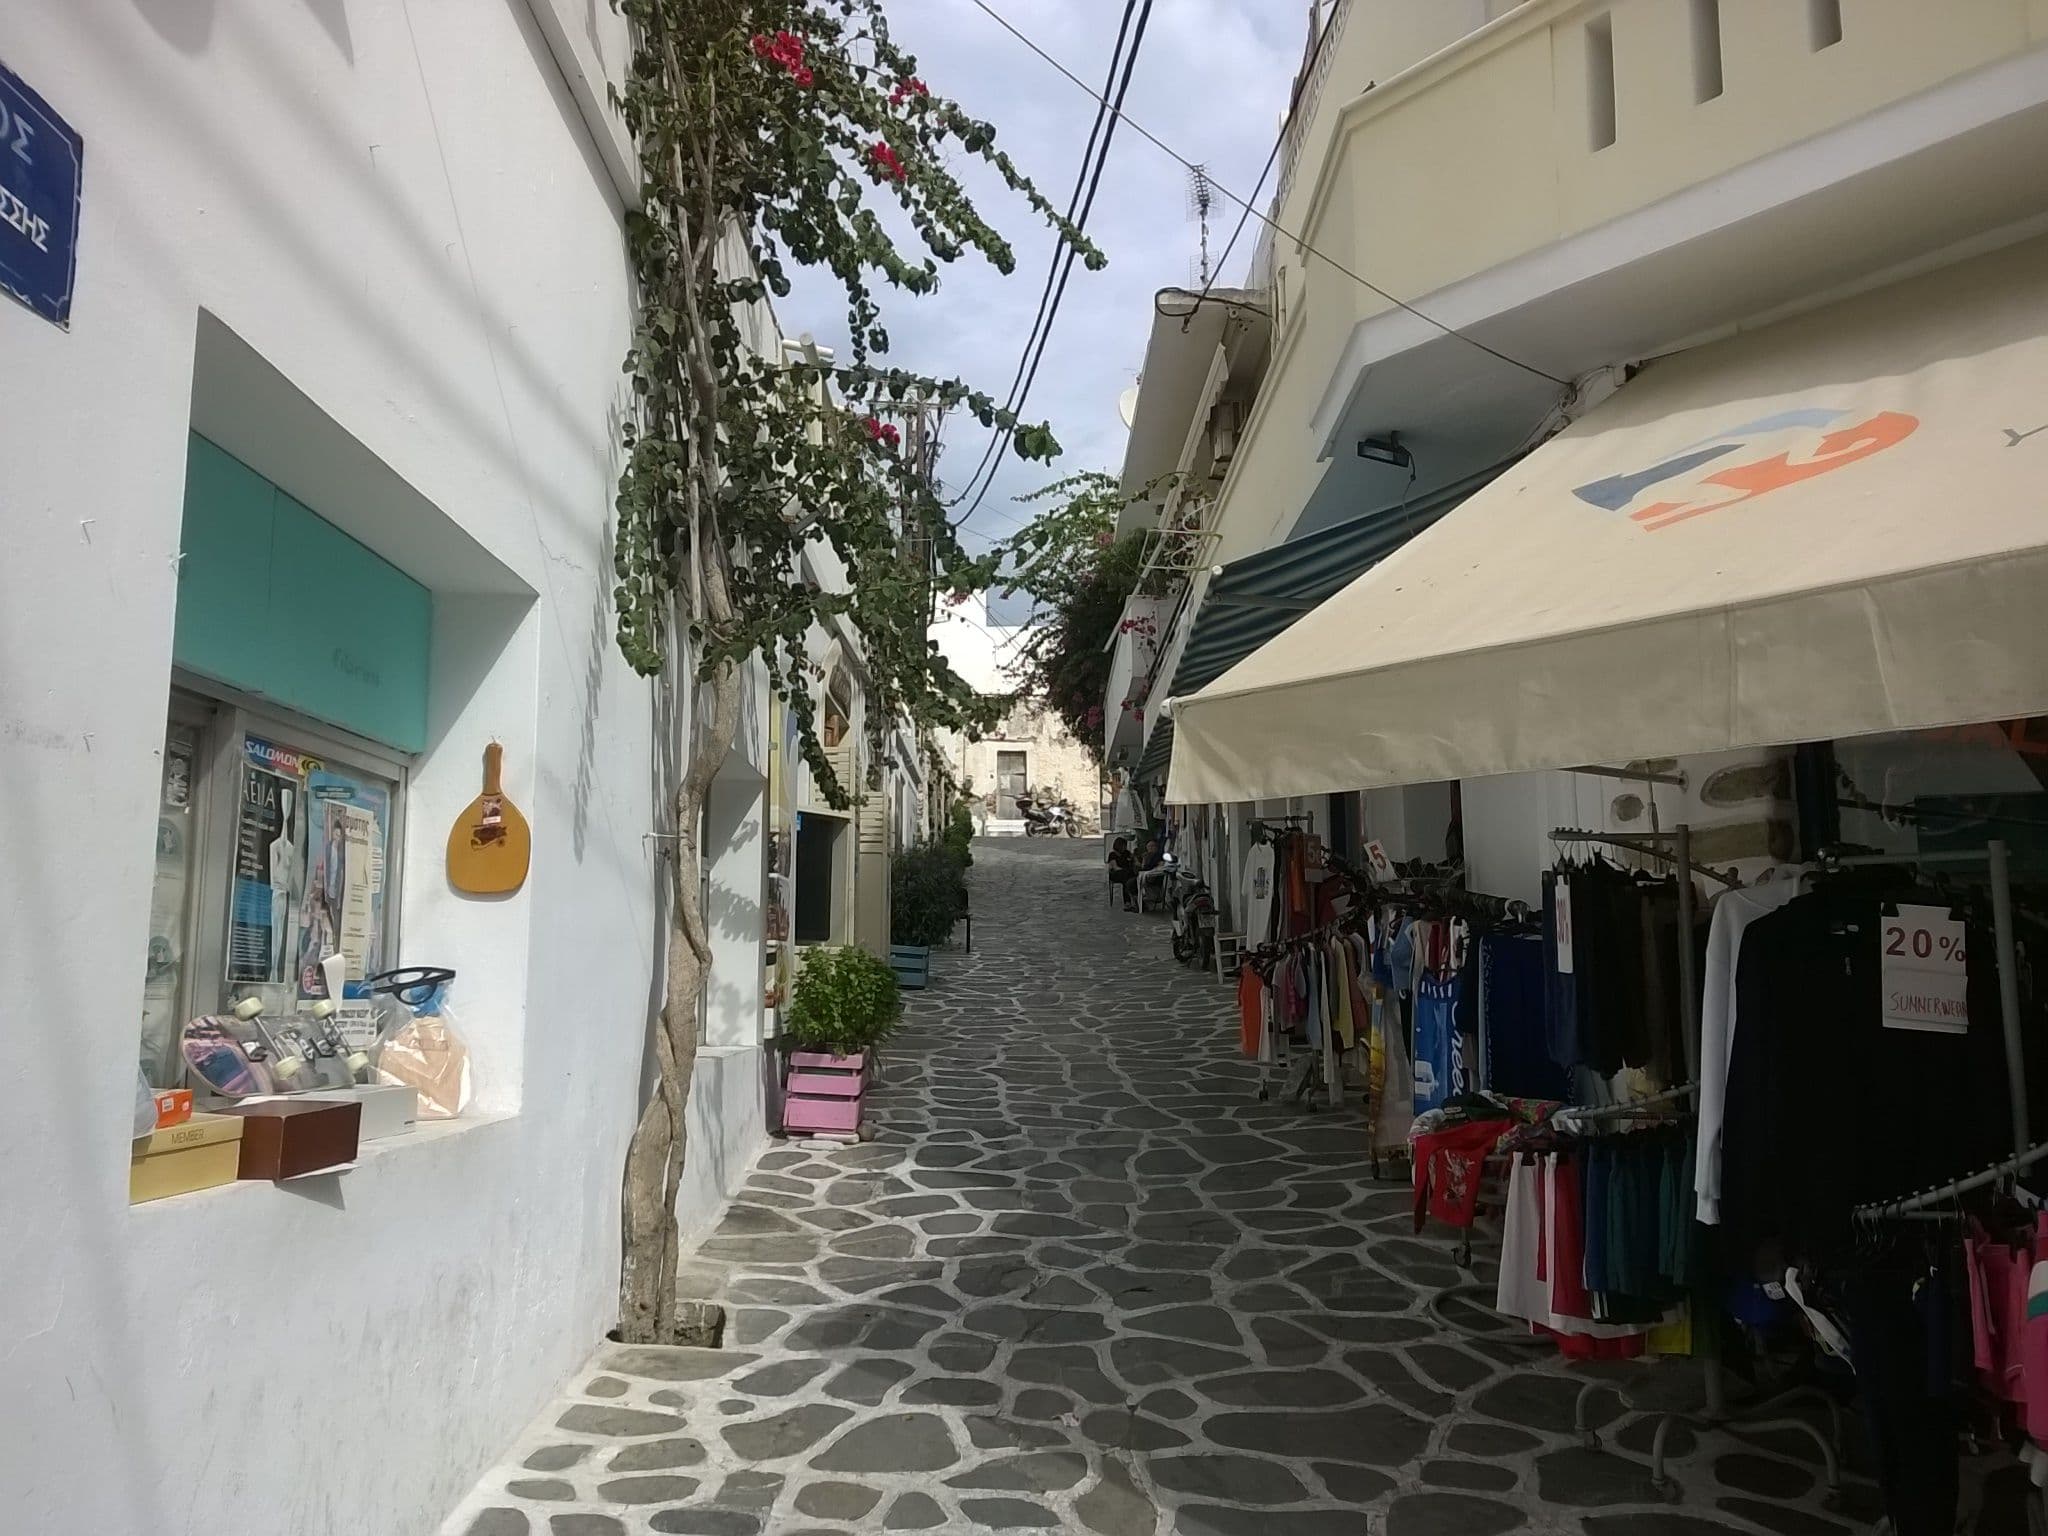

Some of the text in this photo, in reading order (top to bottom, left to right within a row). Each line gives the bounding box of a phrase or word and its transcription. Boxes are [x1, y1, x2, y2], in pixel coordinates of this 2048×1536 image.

[245, 740, 299, 768] SALOMON
[1885, 926, 1967, 962] 20%
[171, 1128, 205, 1145] MEMBER
